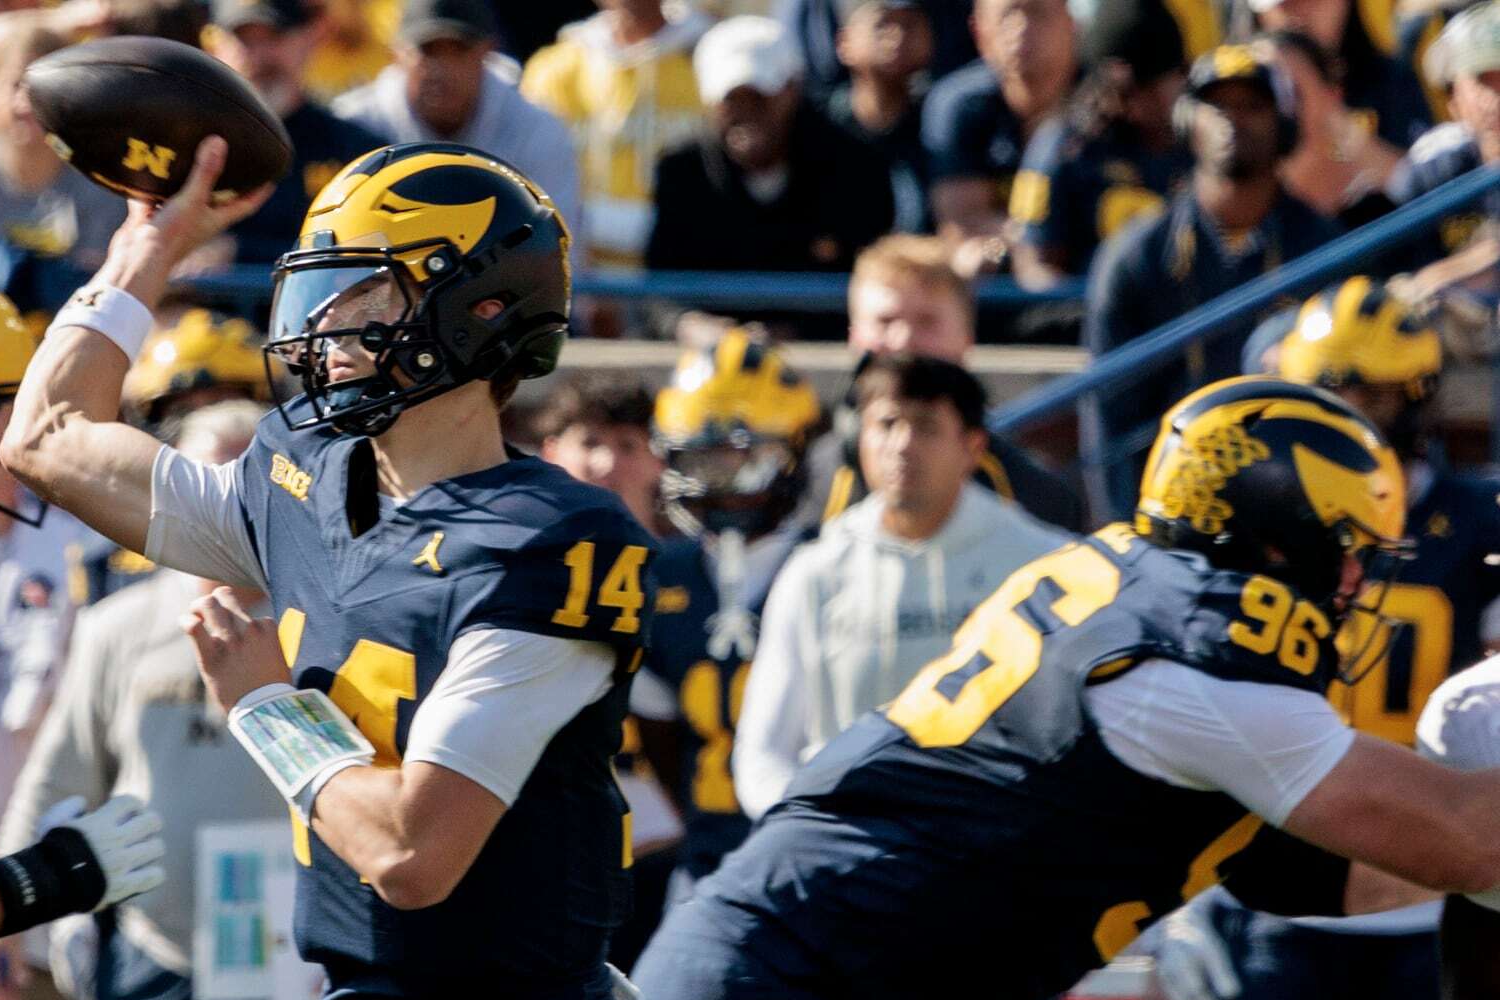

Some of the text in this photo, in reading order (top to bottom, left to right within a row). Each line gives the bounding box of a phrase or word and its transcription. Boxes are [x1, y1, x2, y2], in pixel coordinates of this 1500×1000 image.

[121, 137, 177, 180] M
[551, 540, 649, 634] 14
[1227, 574, 1331, 677] 96
[884, 542, 1122, 749] 6
